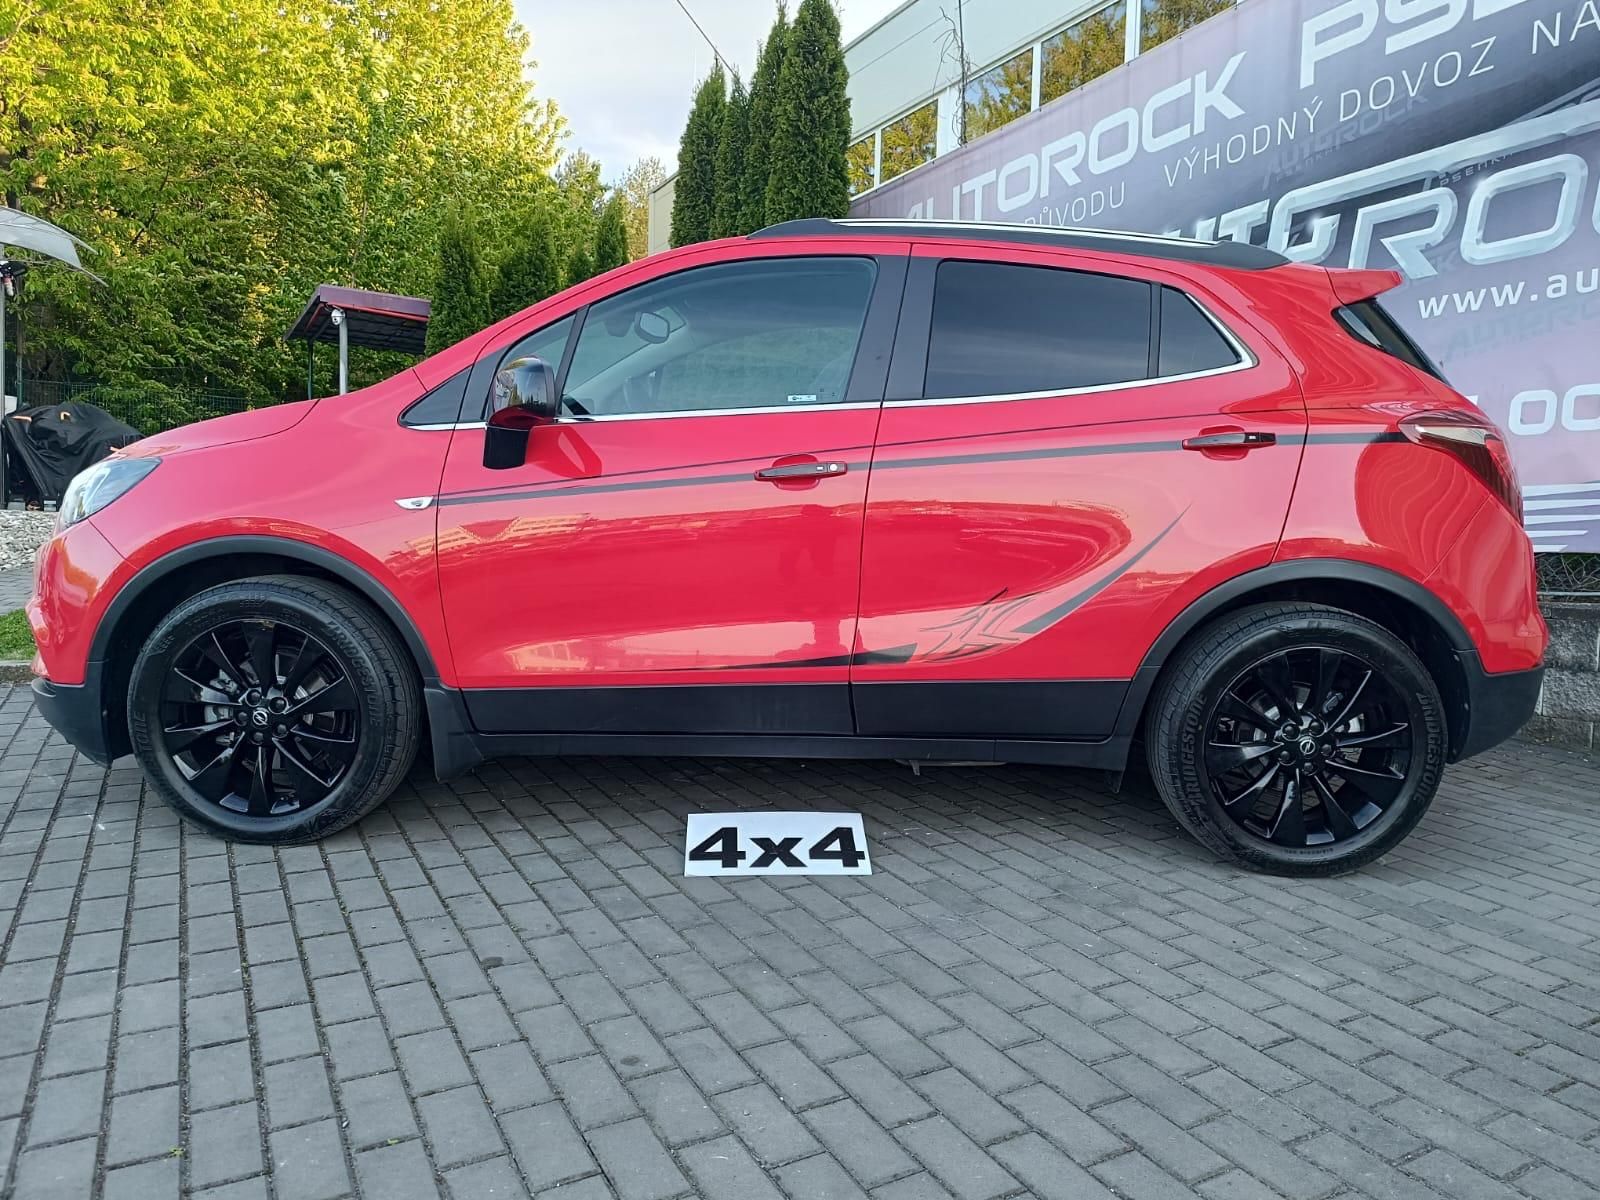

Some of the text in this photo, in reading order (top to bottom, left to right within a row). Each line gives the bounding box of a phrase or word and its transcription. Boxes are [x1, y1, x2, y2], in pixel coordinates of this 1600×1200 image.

[1163, 95, 1324, 188] VÝHODNÝ
[1338, 35, 1498, 122] DOVOZ
[688, 826, 867, 869] 4x4
